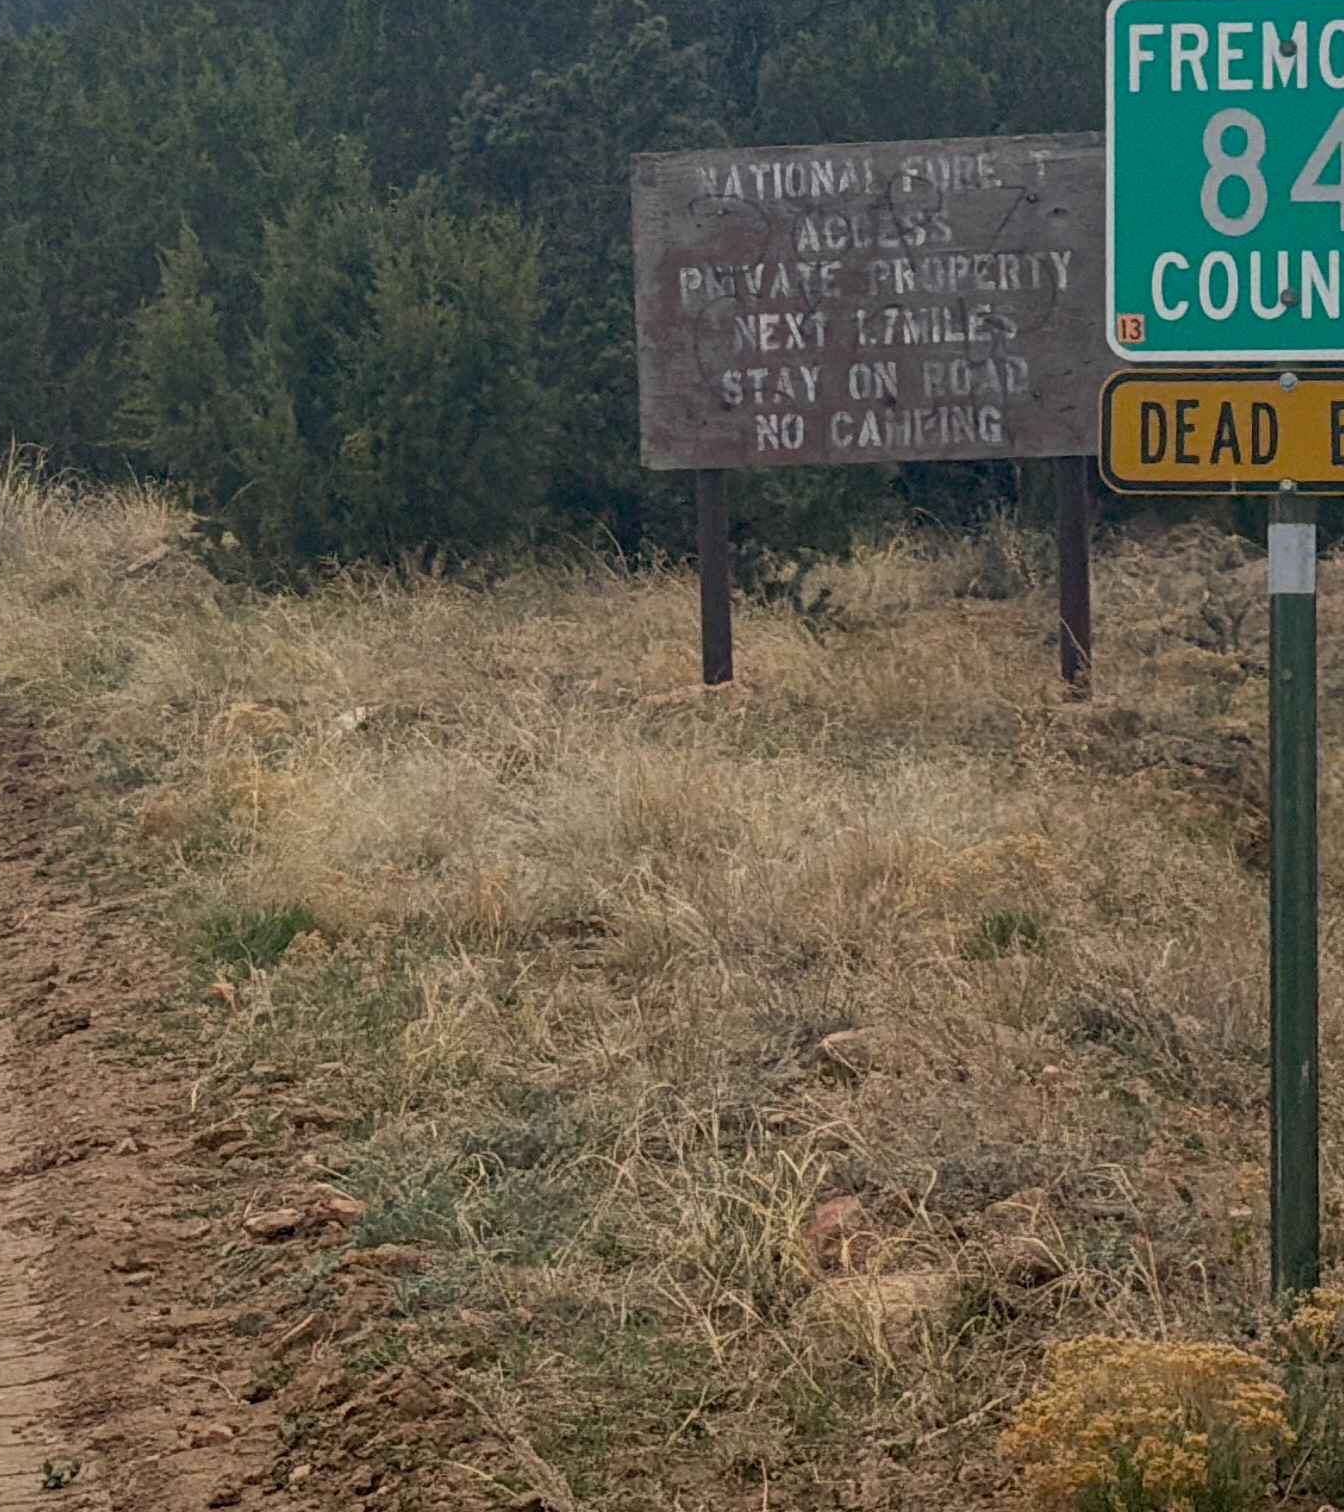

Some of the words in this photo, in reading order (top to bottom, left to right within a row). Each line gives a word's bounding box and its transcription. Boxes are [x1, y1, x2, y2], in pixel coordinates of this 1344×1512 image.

[696, 157, 875, 200] NATIONAL
[903, 149, 1052, 193] FORET
[679, 260, 842, 304] PRIVATE
[867, 250, 1072, 294] PROPERTY
[733, 310, 827, 353] NEXT
[1120, 318, 1141, 340] 13
[720, 366, 820, 406] STAY
[848, 361, 898, 400] ON
[756, 413, 805, 451] NO
[1140, 400, 1278, 465] DEAD
